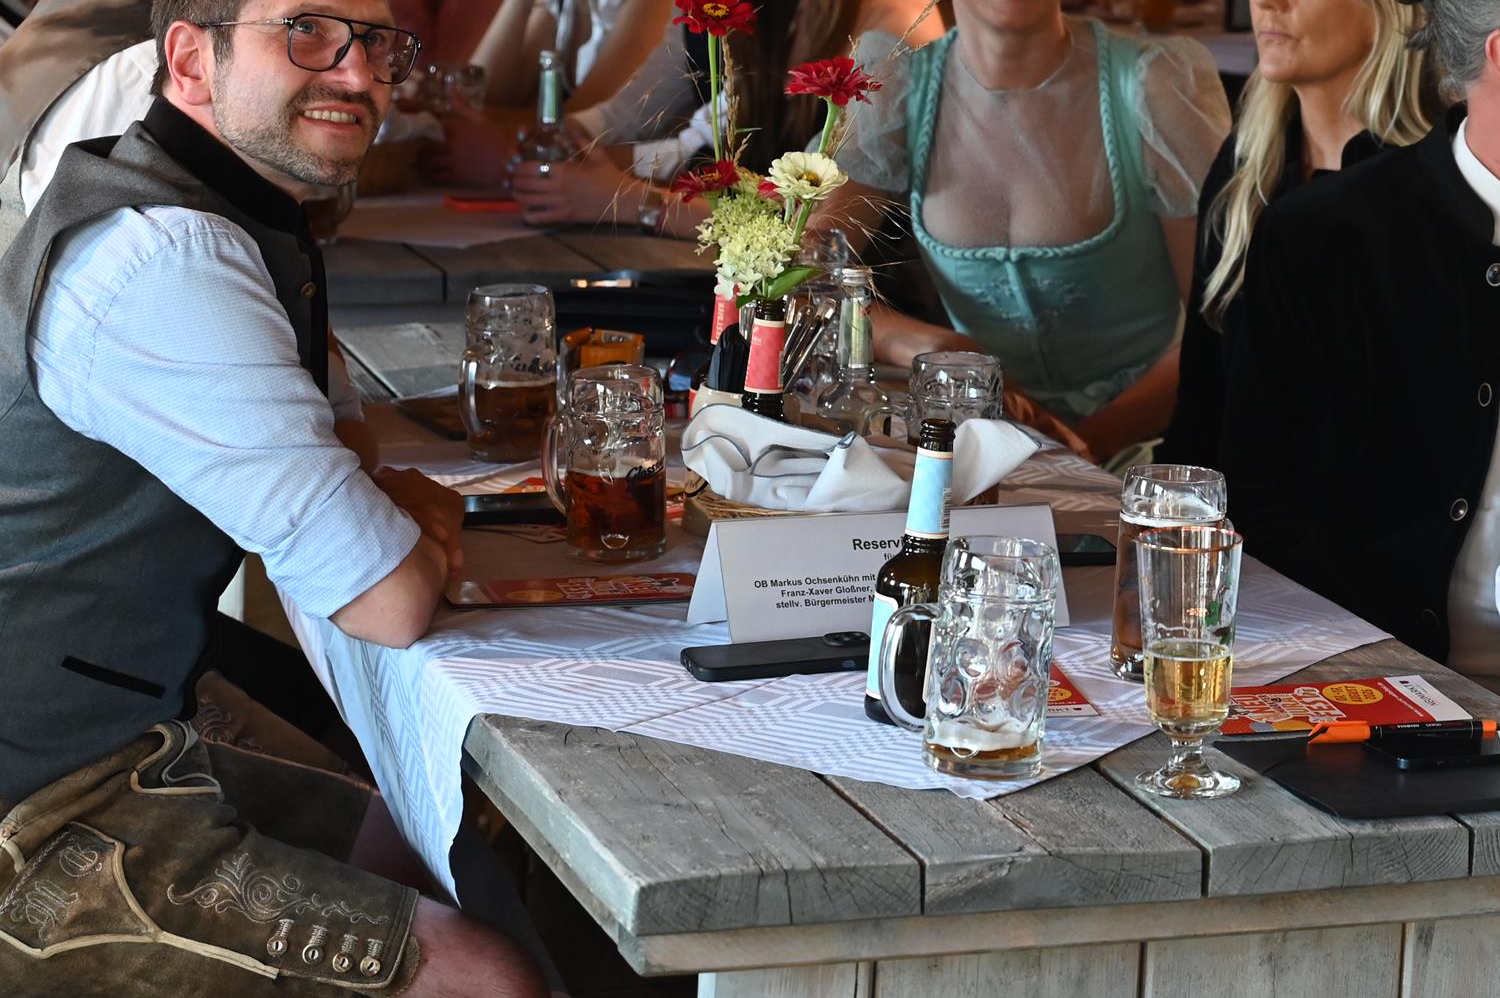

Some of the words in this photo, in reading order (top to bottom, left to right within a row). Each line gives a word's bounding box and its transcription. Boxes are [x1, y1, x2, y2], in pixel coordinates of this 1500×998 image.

[852, 536, 905, 551] Reservi
[754, 580, 768, 588] OB
[770, 578, 803, 587] Markus
[804, 574, 860, 585] Ochsenkühn
[861, 573, 876, 581] mit
[781, 587, 834, 598] Franz-Xaver
[835, 585, 873, 594] Gloßner,
[776, 600, 802, 609] stellv.
[804, 596, 867, 608] Bürgermeister
